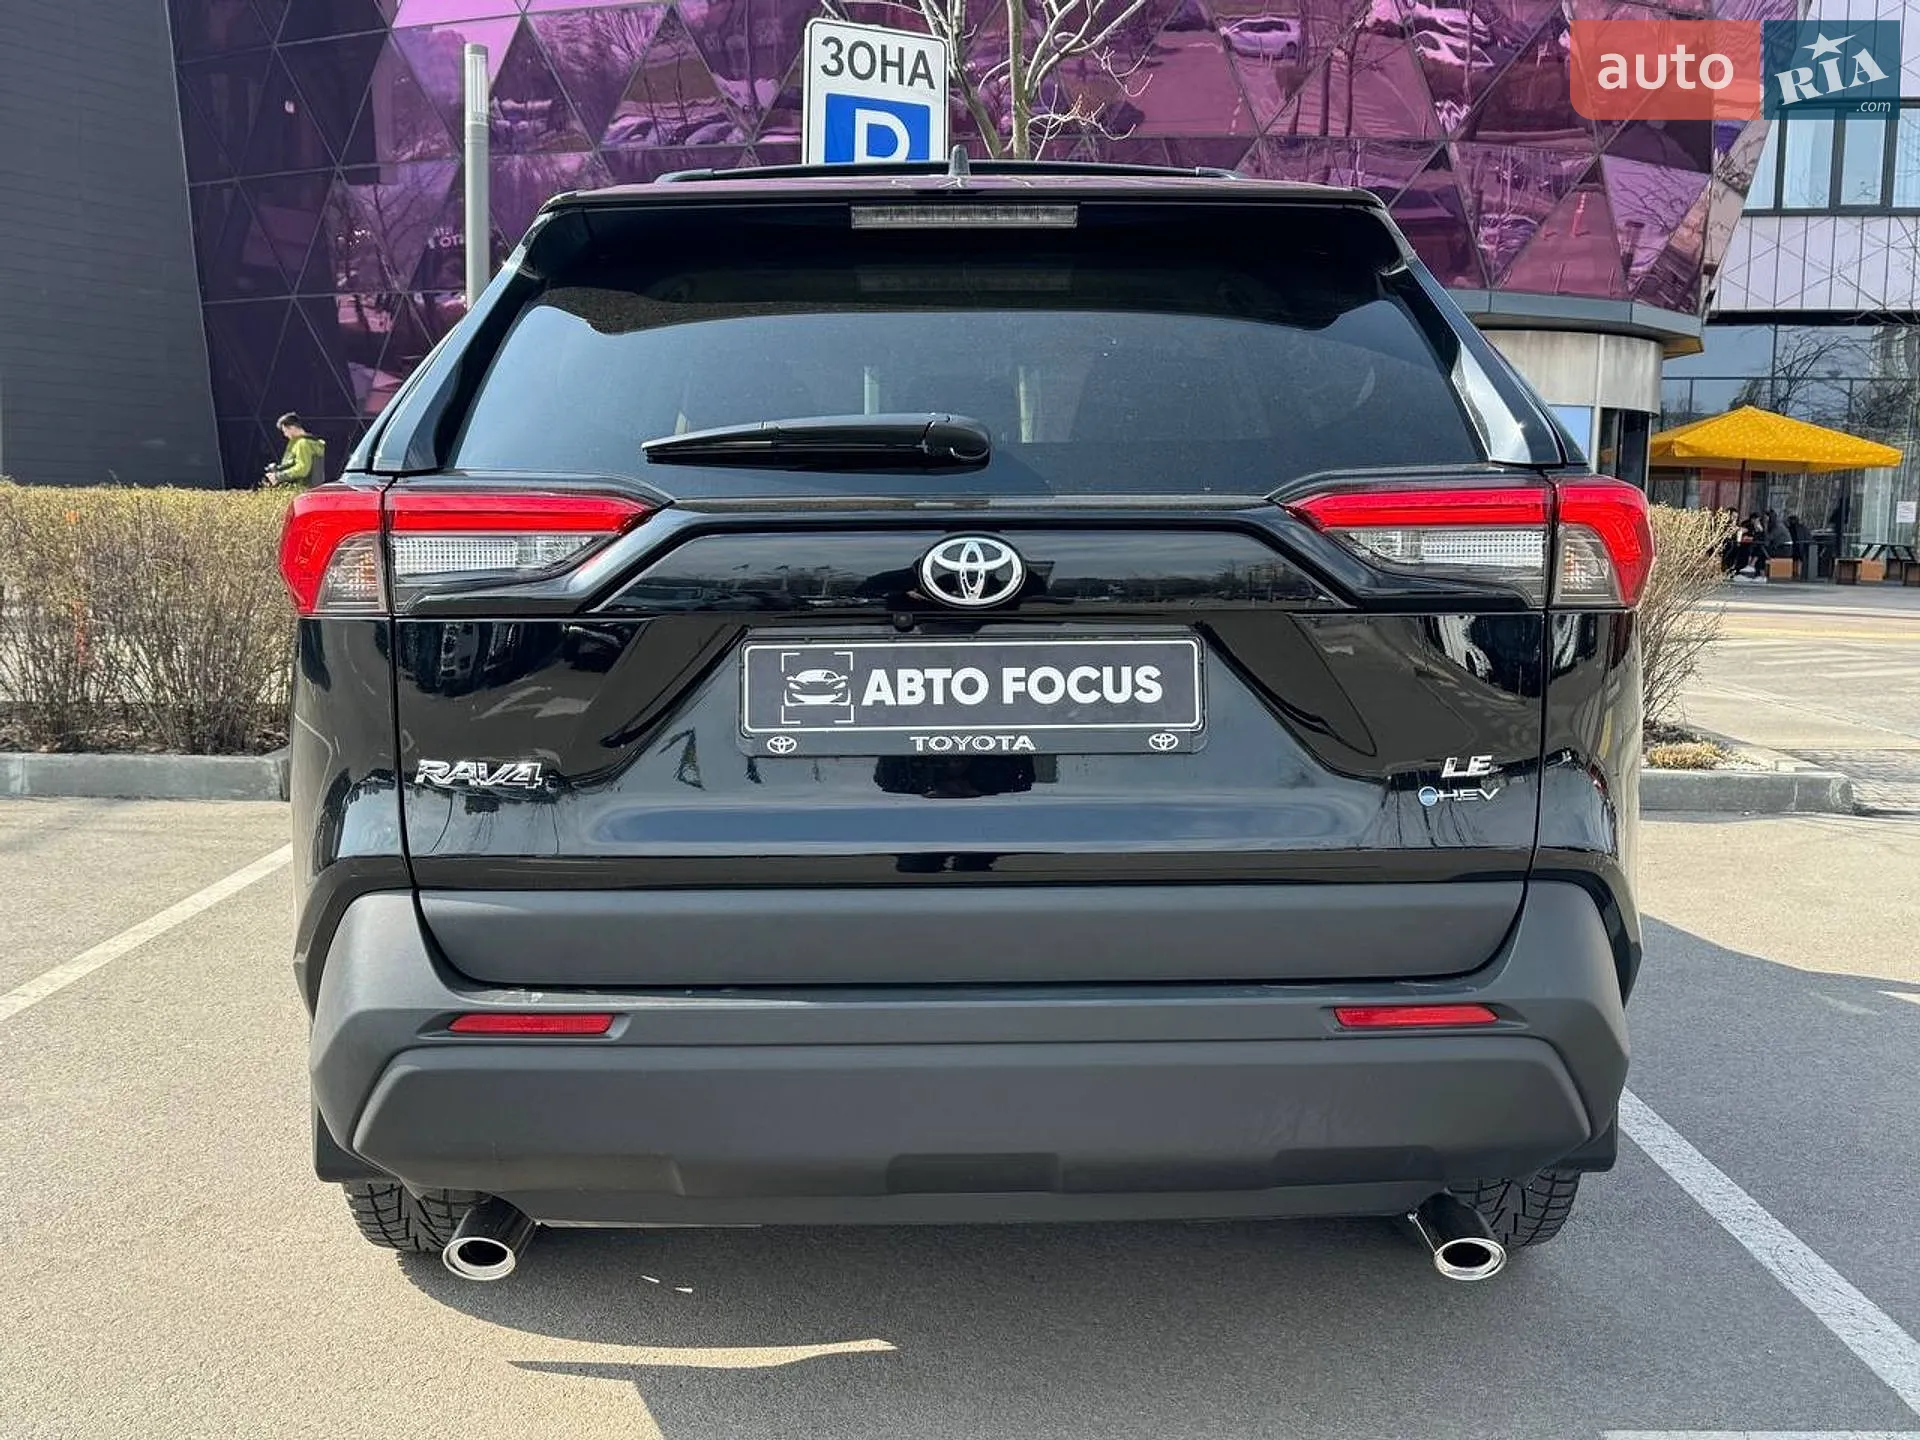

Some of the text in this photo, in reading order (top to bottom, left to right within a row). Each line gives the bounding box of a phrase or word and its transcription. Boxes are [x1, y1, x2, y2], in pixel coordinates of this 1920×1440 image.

[820, 36, 936, 90] ЗОНА
[860, 665, 1164, 706] АВТО FOCUS
[909, 734, 1037, 752] TOYOTA
[414, 759, 543, 790] RAV4
[1441, 754, 1493, 778] LE
